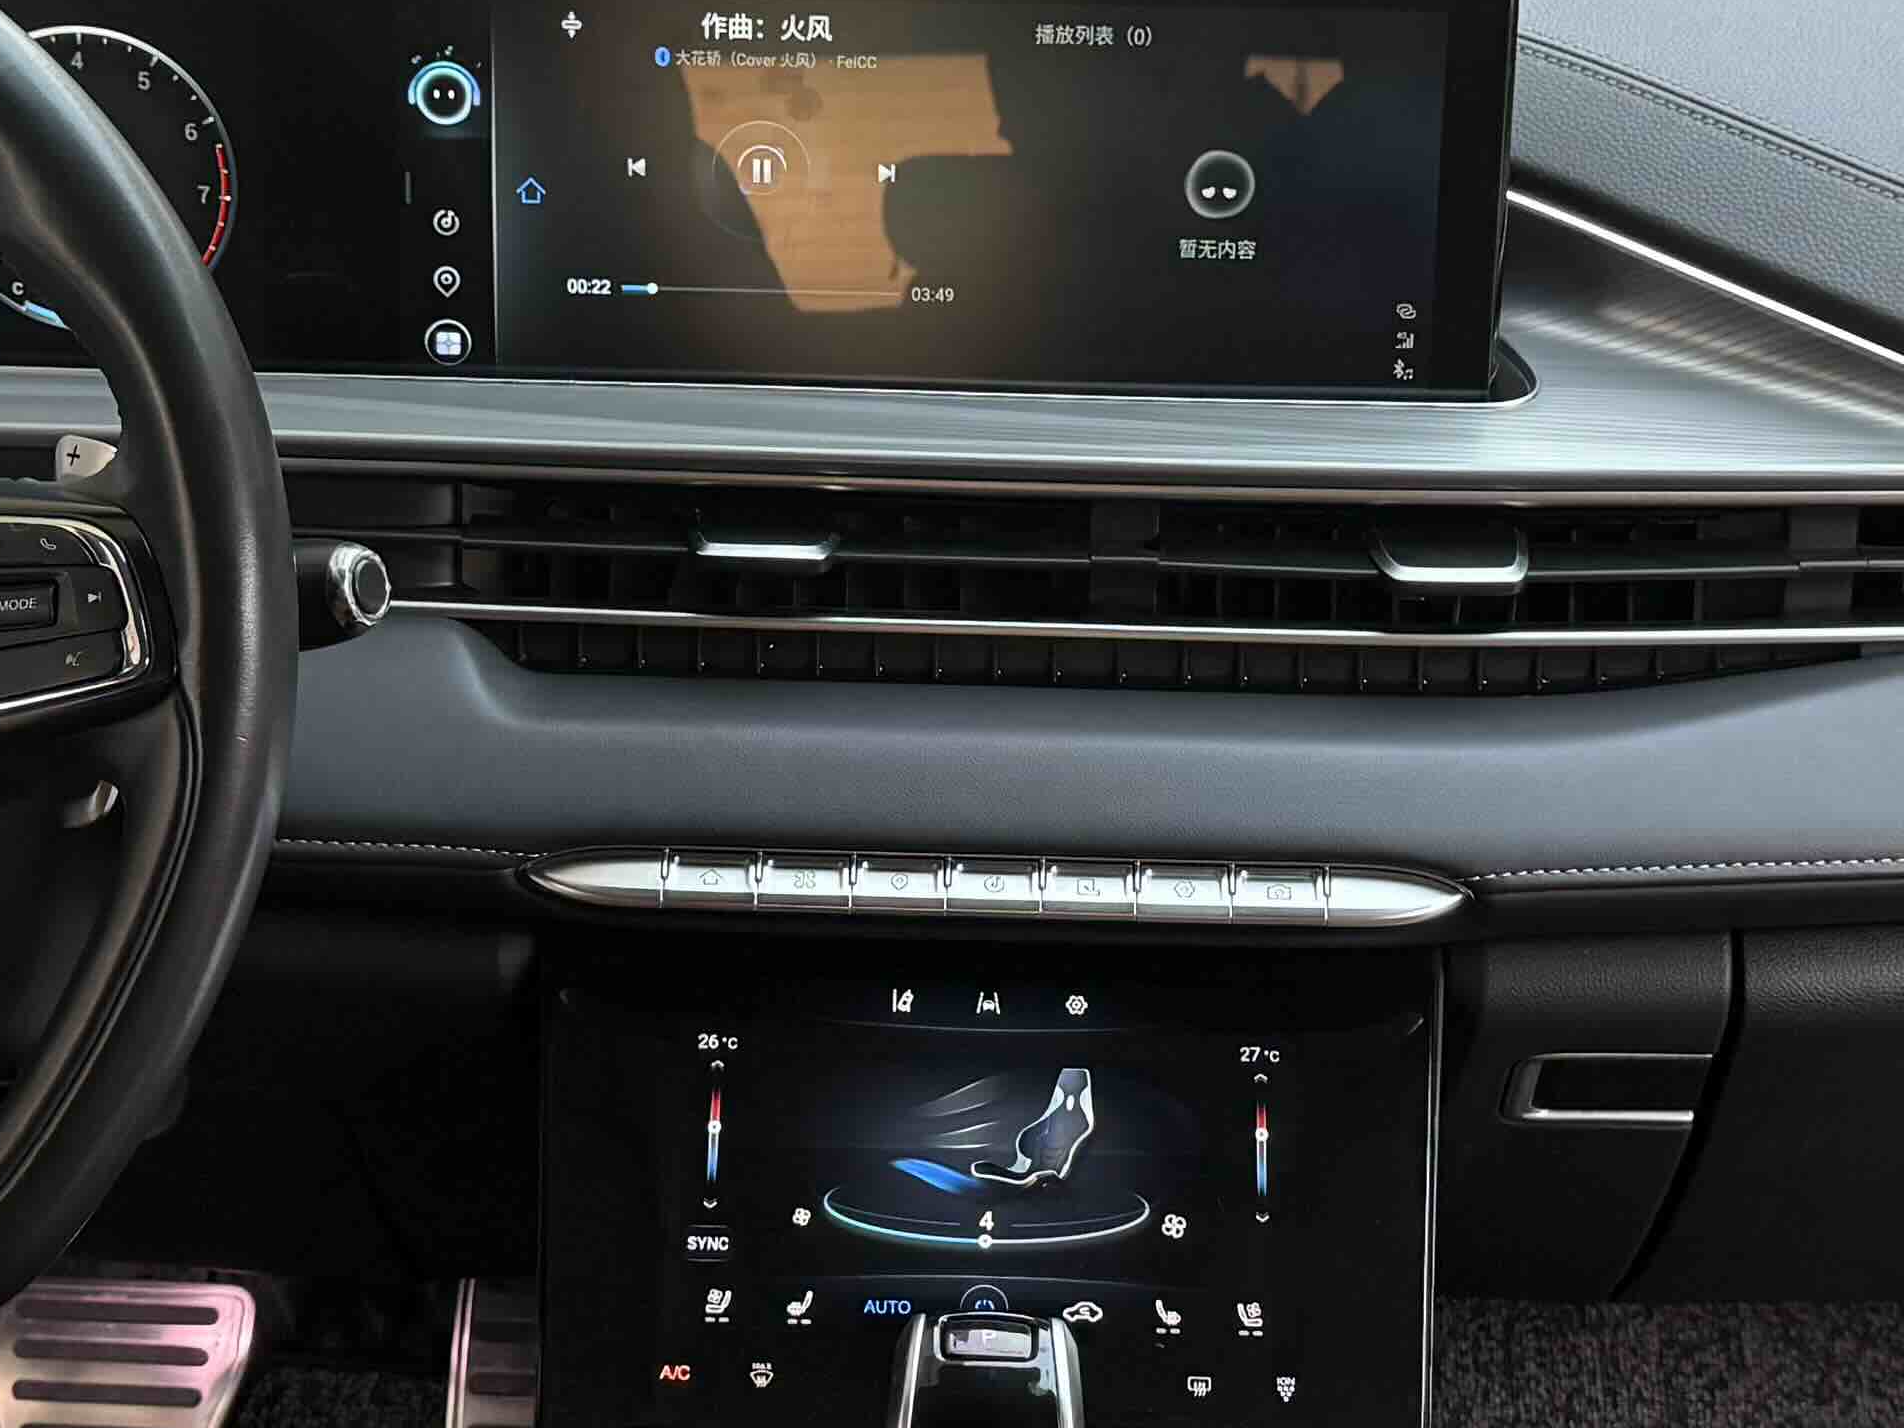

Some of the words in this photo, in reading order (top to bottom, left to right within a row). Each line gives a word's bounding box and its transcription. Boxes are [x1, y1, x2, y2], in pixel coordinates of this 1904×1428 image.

[71, 51, 84, 69] 4
[137, 71, 151, 91] 5
[184, 123, 198, 141] 6
[196, 184, 210, 205] 7
[1179, 238, 1257, 260] 暂无内容
[11, 281, 25, 296] C
[566, 278, 612, 295] 00:22
[910, 286, 955, 303] 03:49
[978, 1211, 995, 1232] 4
[686, 1234, 730, 1253] SYNC
[863, 1298, 912, 1317] AUTO
[659, 1363, 692, 1383] A/C
